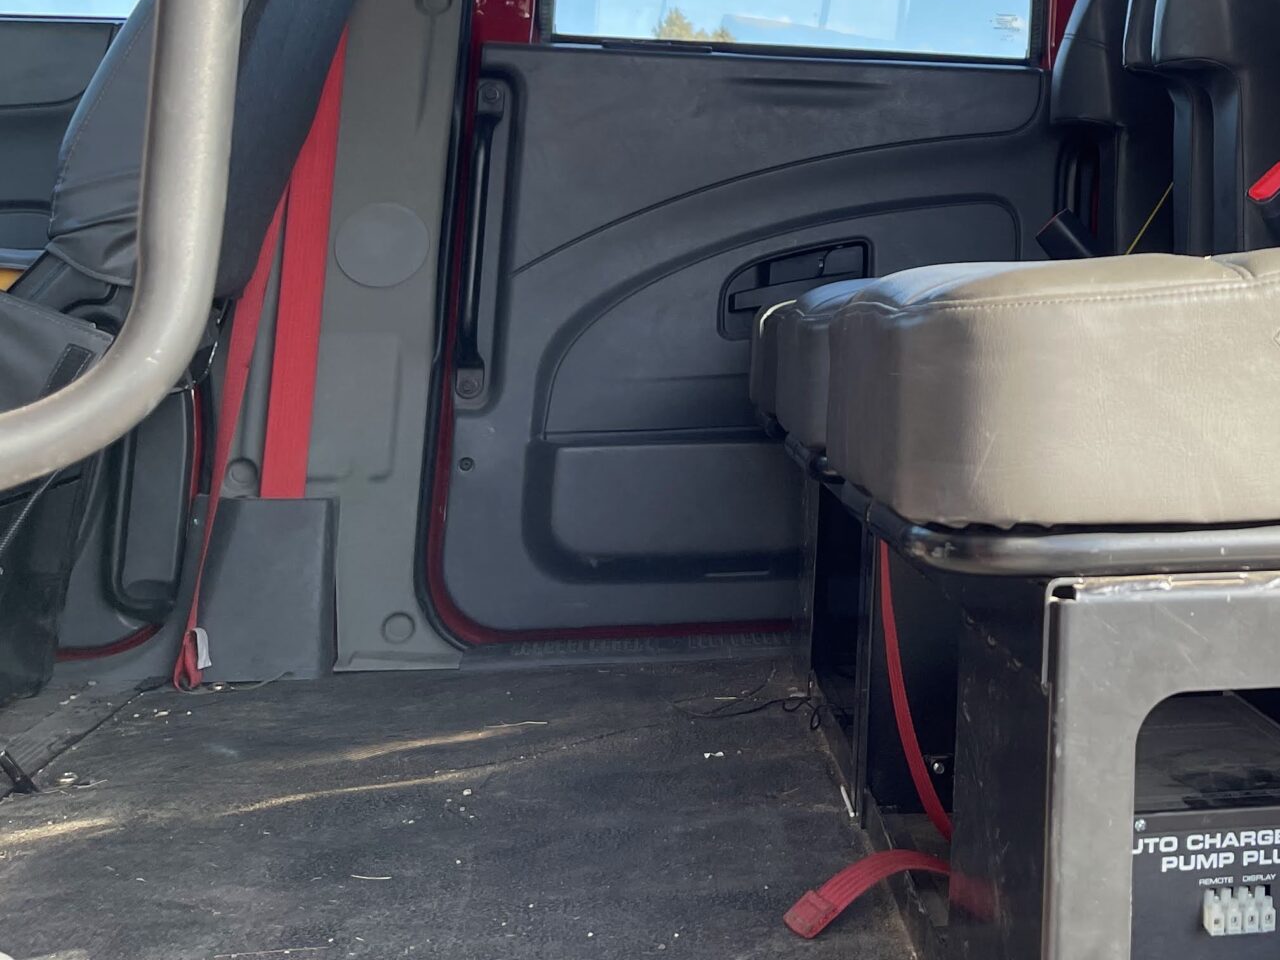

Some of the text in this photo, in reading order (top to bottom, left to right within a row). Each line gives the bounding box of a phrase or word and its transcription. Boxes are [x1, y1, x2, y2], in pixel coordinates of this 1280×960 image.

[1132, 836, 1178, 855] UTO
[1161, 852, 1234, 872] PUMP
[1199, 873, 1276, 885] REMOTE DISPLAY
